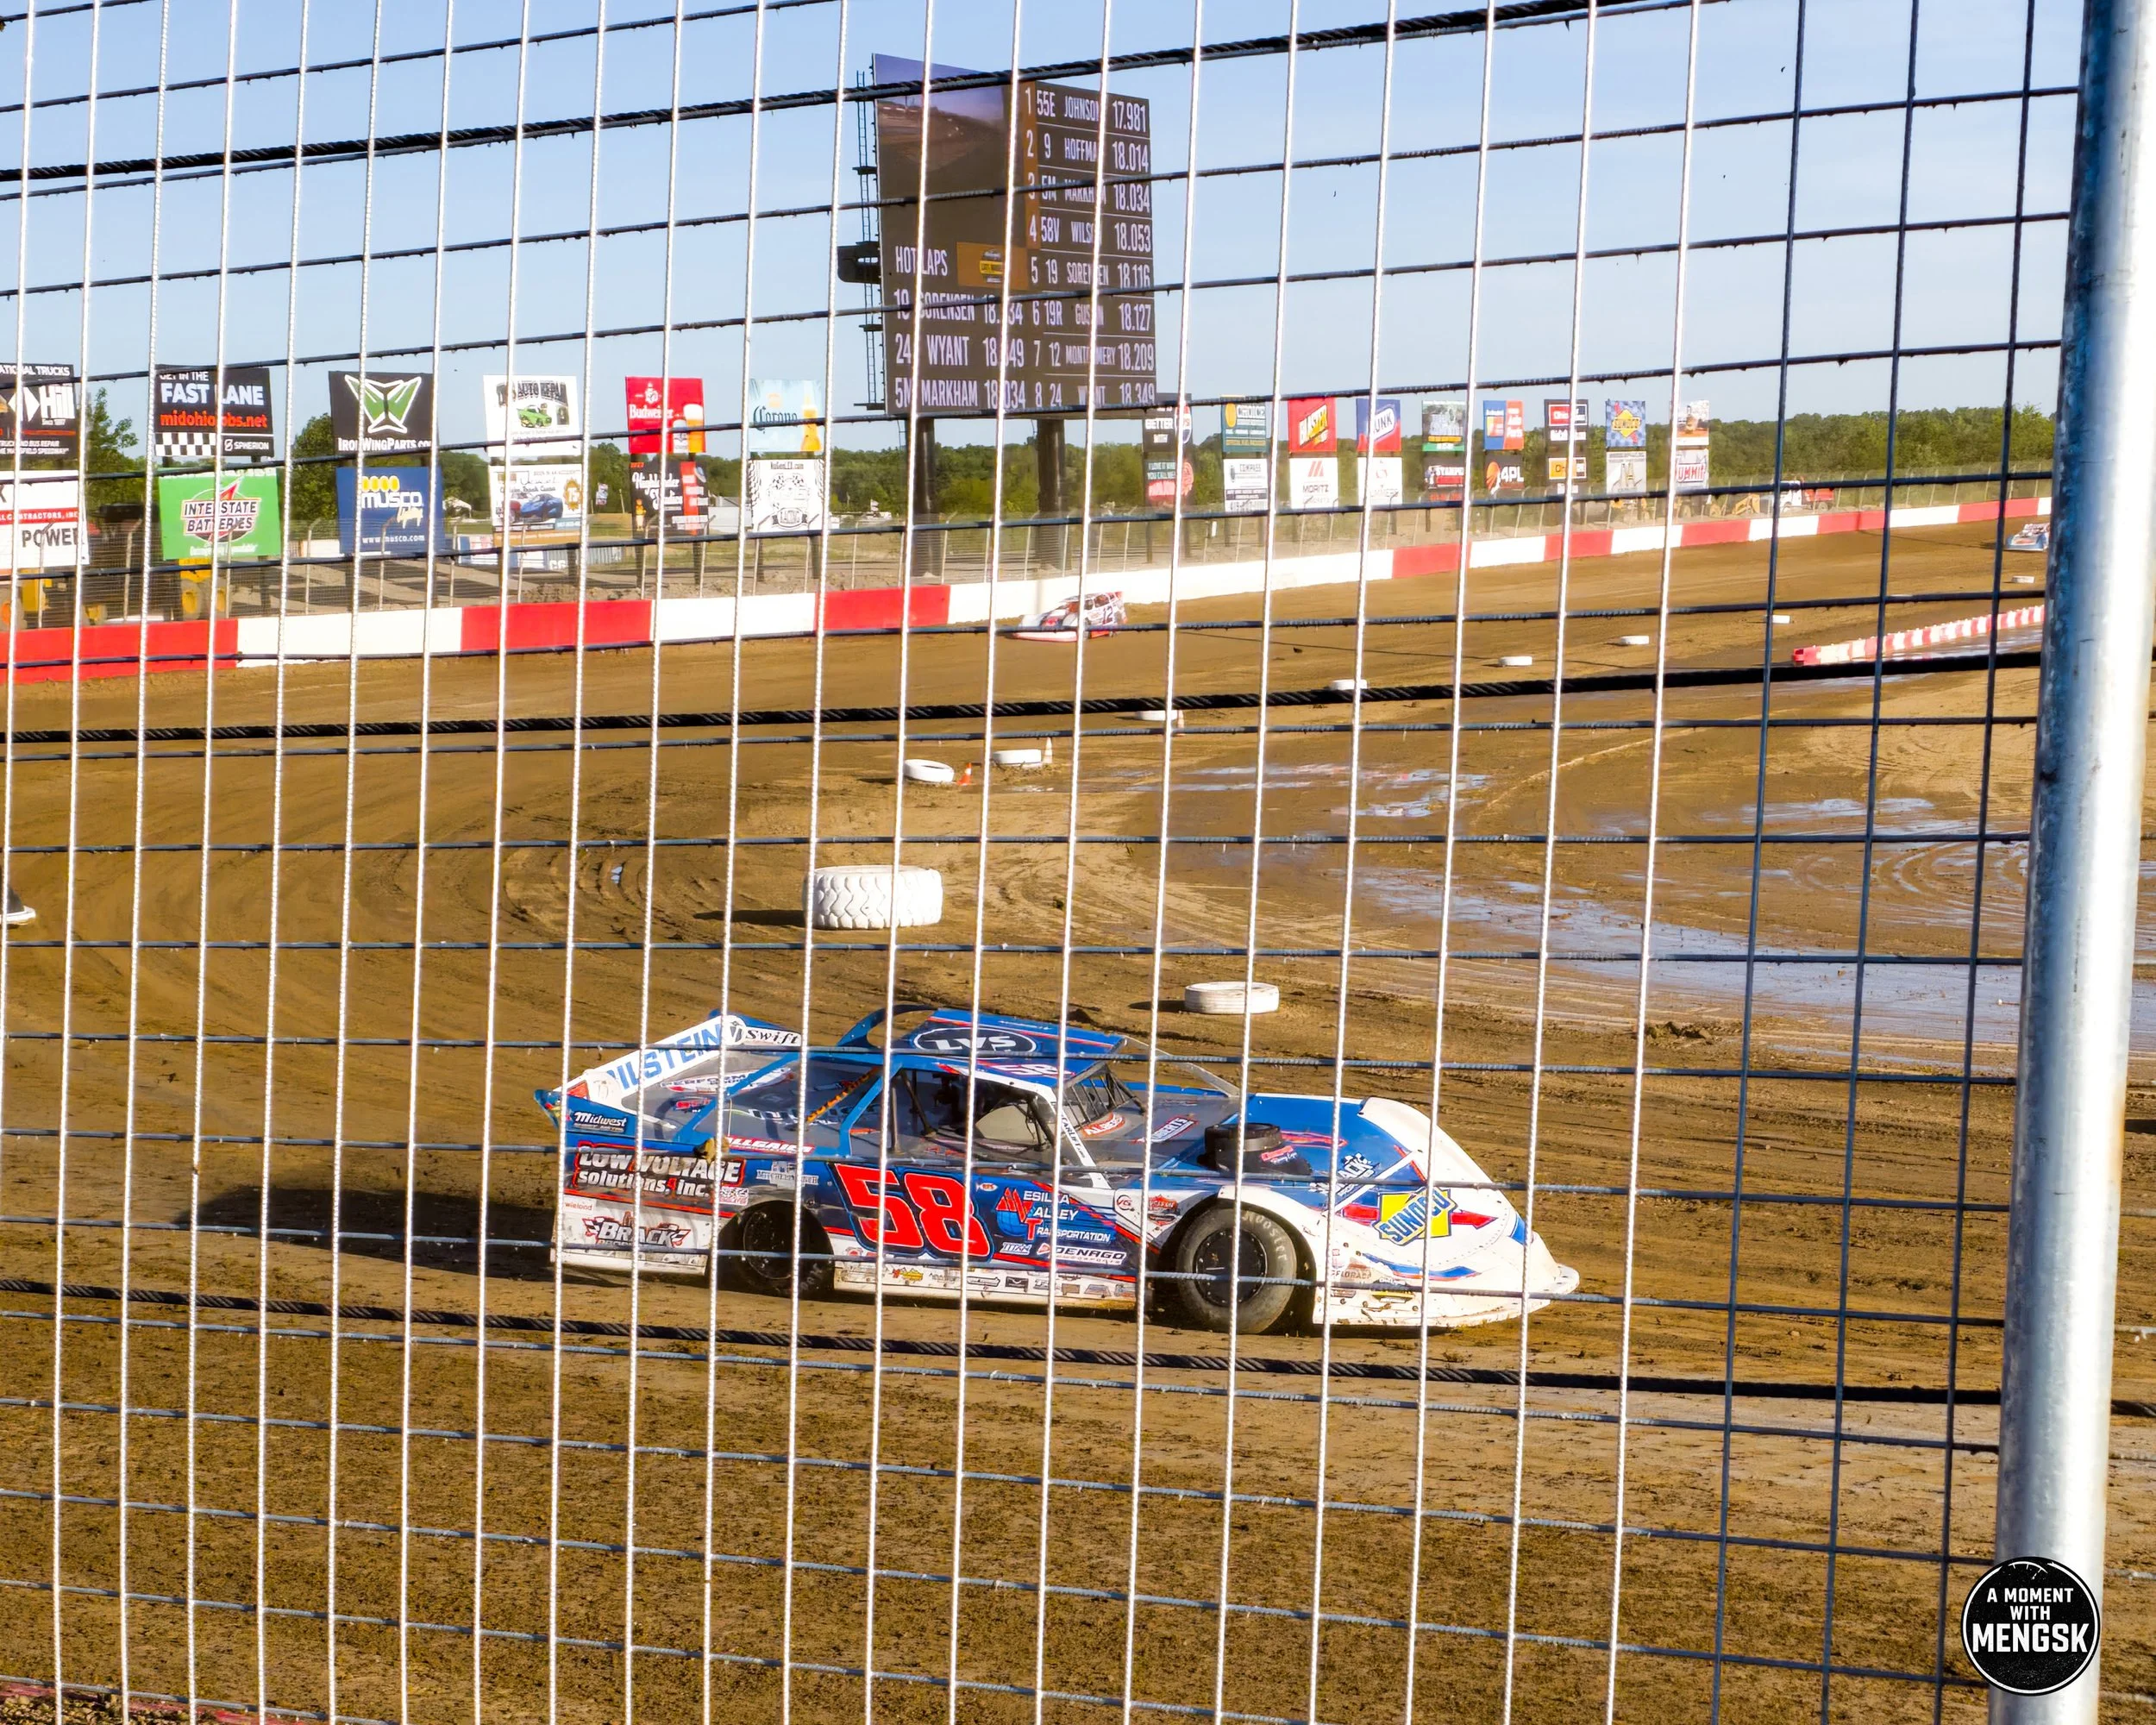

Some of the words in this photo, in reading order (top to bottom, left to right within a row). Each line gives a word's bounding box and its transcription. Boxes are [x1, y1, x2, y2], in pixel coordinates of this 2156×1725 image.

[1025, 87, 1031, 115] 1
[1037, 90, 1056, 117] 55E
[1112, 100, 1146, 133] 17.981
[1026, 129, 1034, 157] 2
[1044, 133, 1051, 159] 9
[1064, 138, 1098, 162] HOFFMA
[1112, 141, 1149, 172] 18.014
[1064, 179, 1106, 204] MARKHM
[1113, 183, 1150, 213] 18.034
[1029, 215, 1037, 242] 4
[1041, 216, 1060, 242] 58V
[1071, 221, 1102, 245] WILS
[1114, 223, 1151, 252] 18.053
[895, 246, 917, 273] HOT
[921, 248, 948, 276] LAPS
[1031, 256, 1038, 284] 5
[1045, 259, 1058, 284] 19
[1066, 261, 1109, 285] SOREEN
[1118, 262, 1150, 290] 18116
[920, 291, 975, 322] SORENSEN
[983, 293, 1023, 325] 18.34
[1032, 300, 1040, 326] 6
[1044, 300, 1062, 326] 19R
[1075, 304, 1104, 326] GUSN
[1119, 303, 1151, 331] 18.127
[895, 333, 912, 364] 24
[926, 335, 969, 366] WYANT
[982, 336, 1025, 367] 1849
[1034, 340, 1041, 367] 7
[1049, 342, 1061, 367] 12
[1066, 345, 1116, 366] MONTMERY
[1118, 342, 1155, 371] 18.209
[36, 367, 70, 376] TRUCKS
[191, 371, 209, 380] THE
[160, 383, 210, 404] FAST
[921, 380, 978, 406] MARKHAM
[984, 380, 1025, 410] 18034
[1035, 381, 1043, 408] 8
[1050, 383, 1062, 407] 24
[1078, 386, 1106, 410] WNT
[1119, 382, 1156, 407] 18349
[160, 410, 267, 428] midohioobs.net
[629, 404, 674, 419] Budweier
[1677, 464, 1705, 480] UMMIT
[7, 511, 65, 521] CNTRACTORS,
[184, 502, 257, 516] INTESTATE
[187, 517, 253, 531] BATERIES
[362, 535, 425, 543] wwwmusco.com
[745, 1028, 799, 1044] Swift
[573, 1112, 628, 1128] Midwest
[579, 1146, 632, 1172] LOW
[636, 1155, 742, 1182] VOLTAGE
[579, 1170, 670, 1195] solutins,
[677, 1181, 710, 1198] inc.
[834, 1164, 991, 1257] 58
[1379, 1189, 1451, 1243] SUNOCO
[1056, 1247, 1125, 1260] DENAGO
